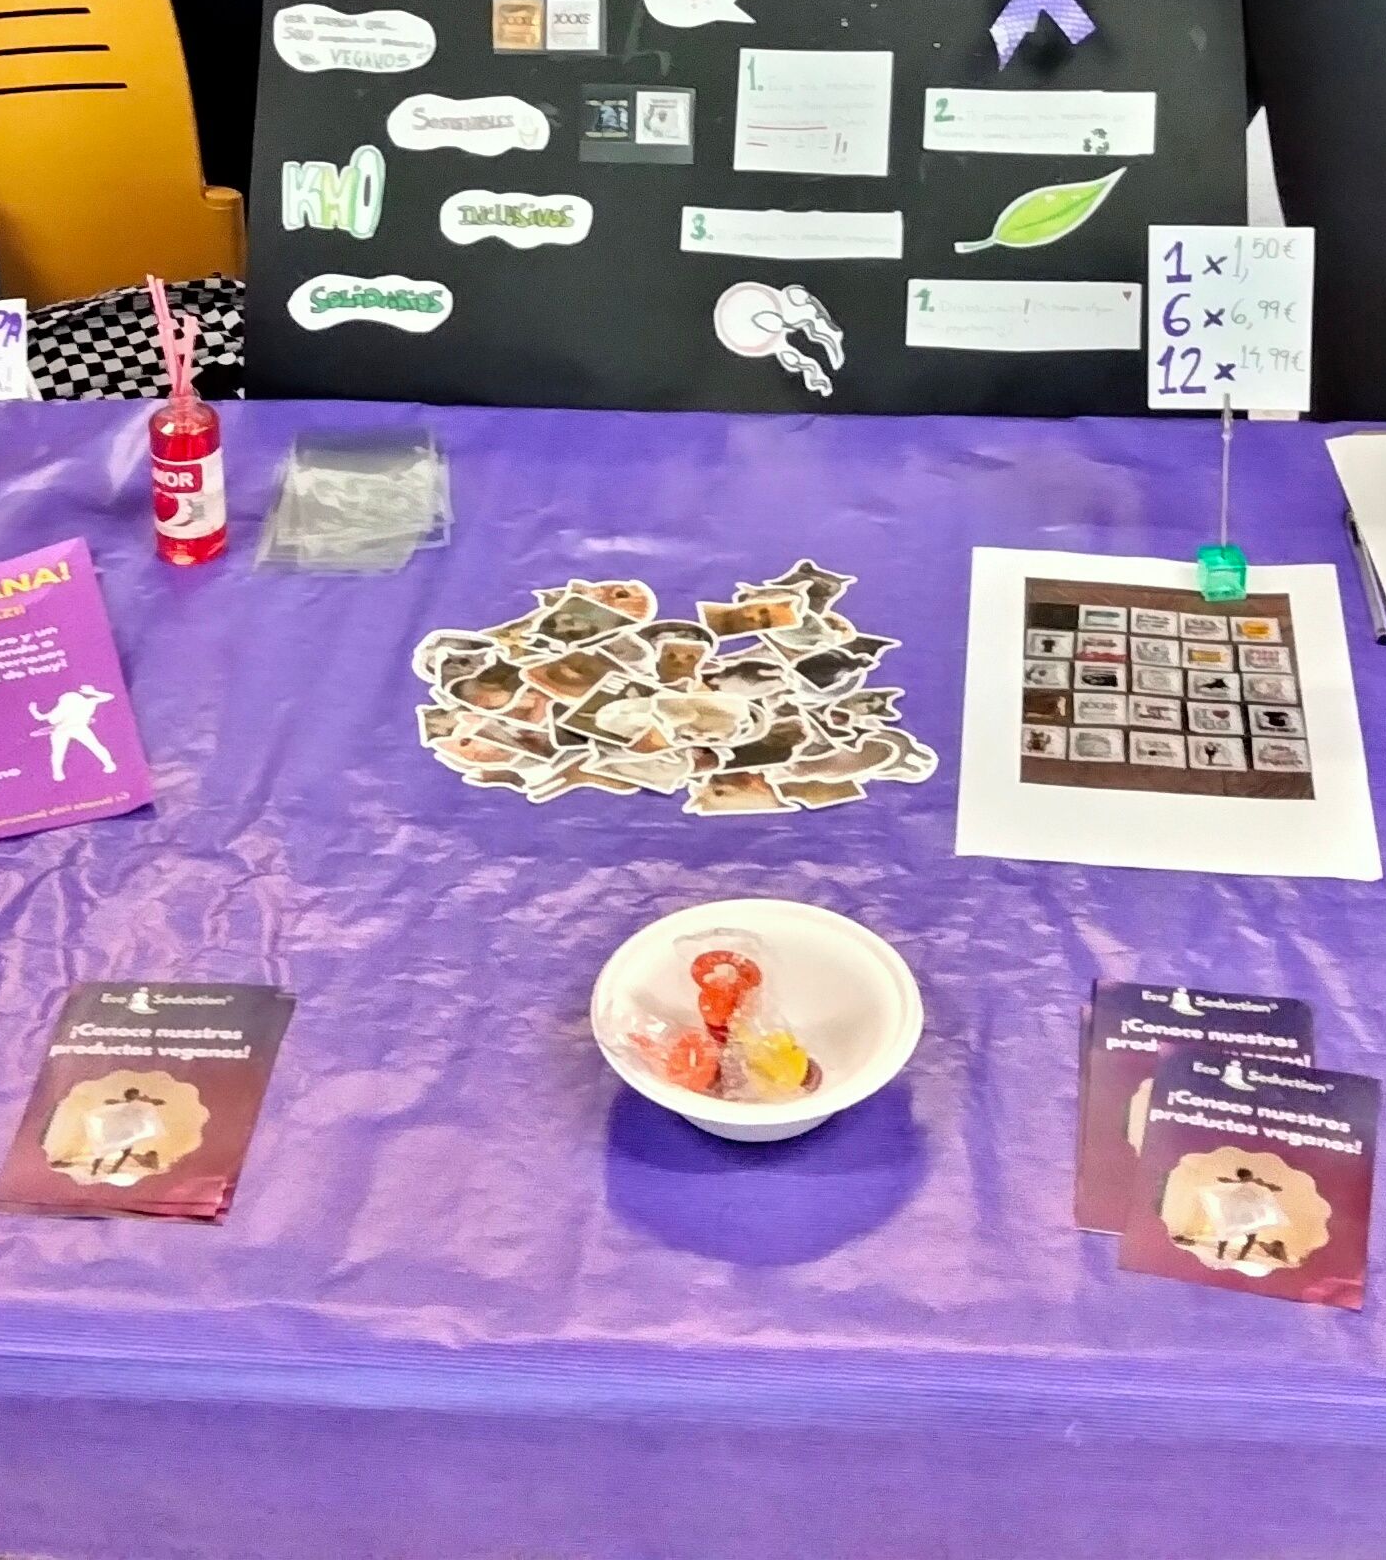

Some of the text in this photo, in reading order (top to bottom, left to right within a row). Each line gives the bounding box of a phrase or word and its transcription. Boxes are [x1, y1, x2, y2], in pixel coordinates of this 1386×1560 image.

[1164, 241, 1192, 283] 1
[1163, 293, 1192, 337] 6
[1156, 345, 1207, 395] 12
[1140, 989, 1169, 1003] Eco
[68, 1022, 244, 1041] ¡Conoce nuestros
[1120, 1017, 1299, 1050] ¡Conoce nuestros
[48, 1041, 252, 1062] productos veganos!
[1192, 1060, 1221, 1076] Eco
[1166, 1089, 1351, 1133] ¡Conoce nuestros
[1149, 1108, 1364, 1155] productos veganos!
